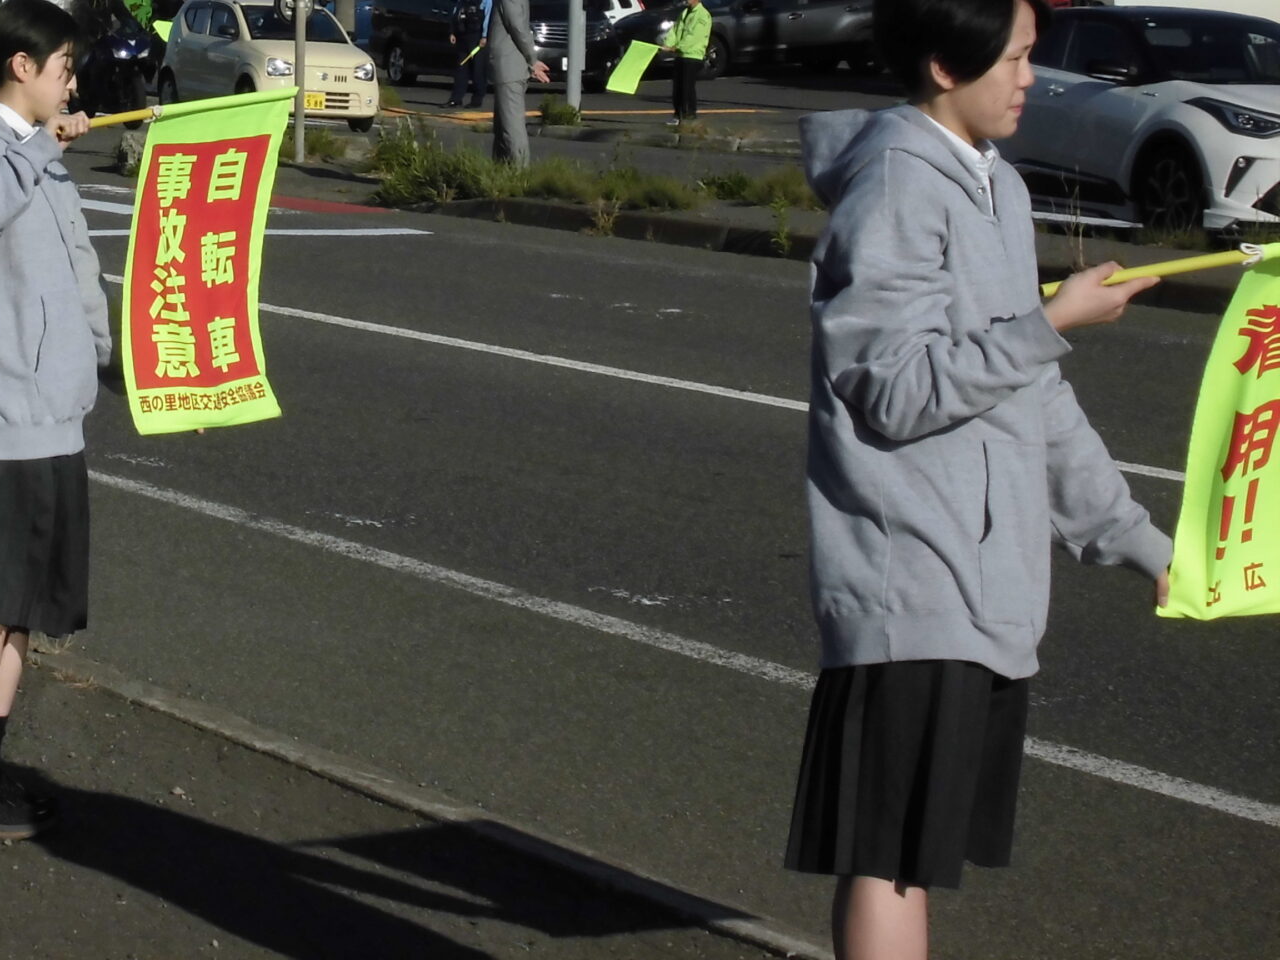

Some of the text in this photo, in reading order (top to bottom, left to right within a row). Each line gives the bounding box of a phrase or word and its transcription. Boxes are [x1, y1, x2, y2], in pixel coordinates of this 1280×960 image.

[149, 152, 200, 379] 事故注意
[200, 148, 249, 373] 自転車
[138, 381, 266, 413] 西の里地区交通安全協議会
